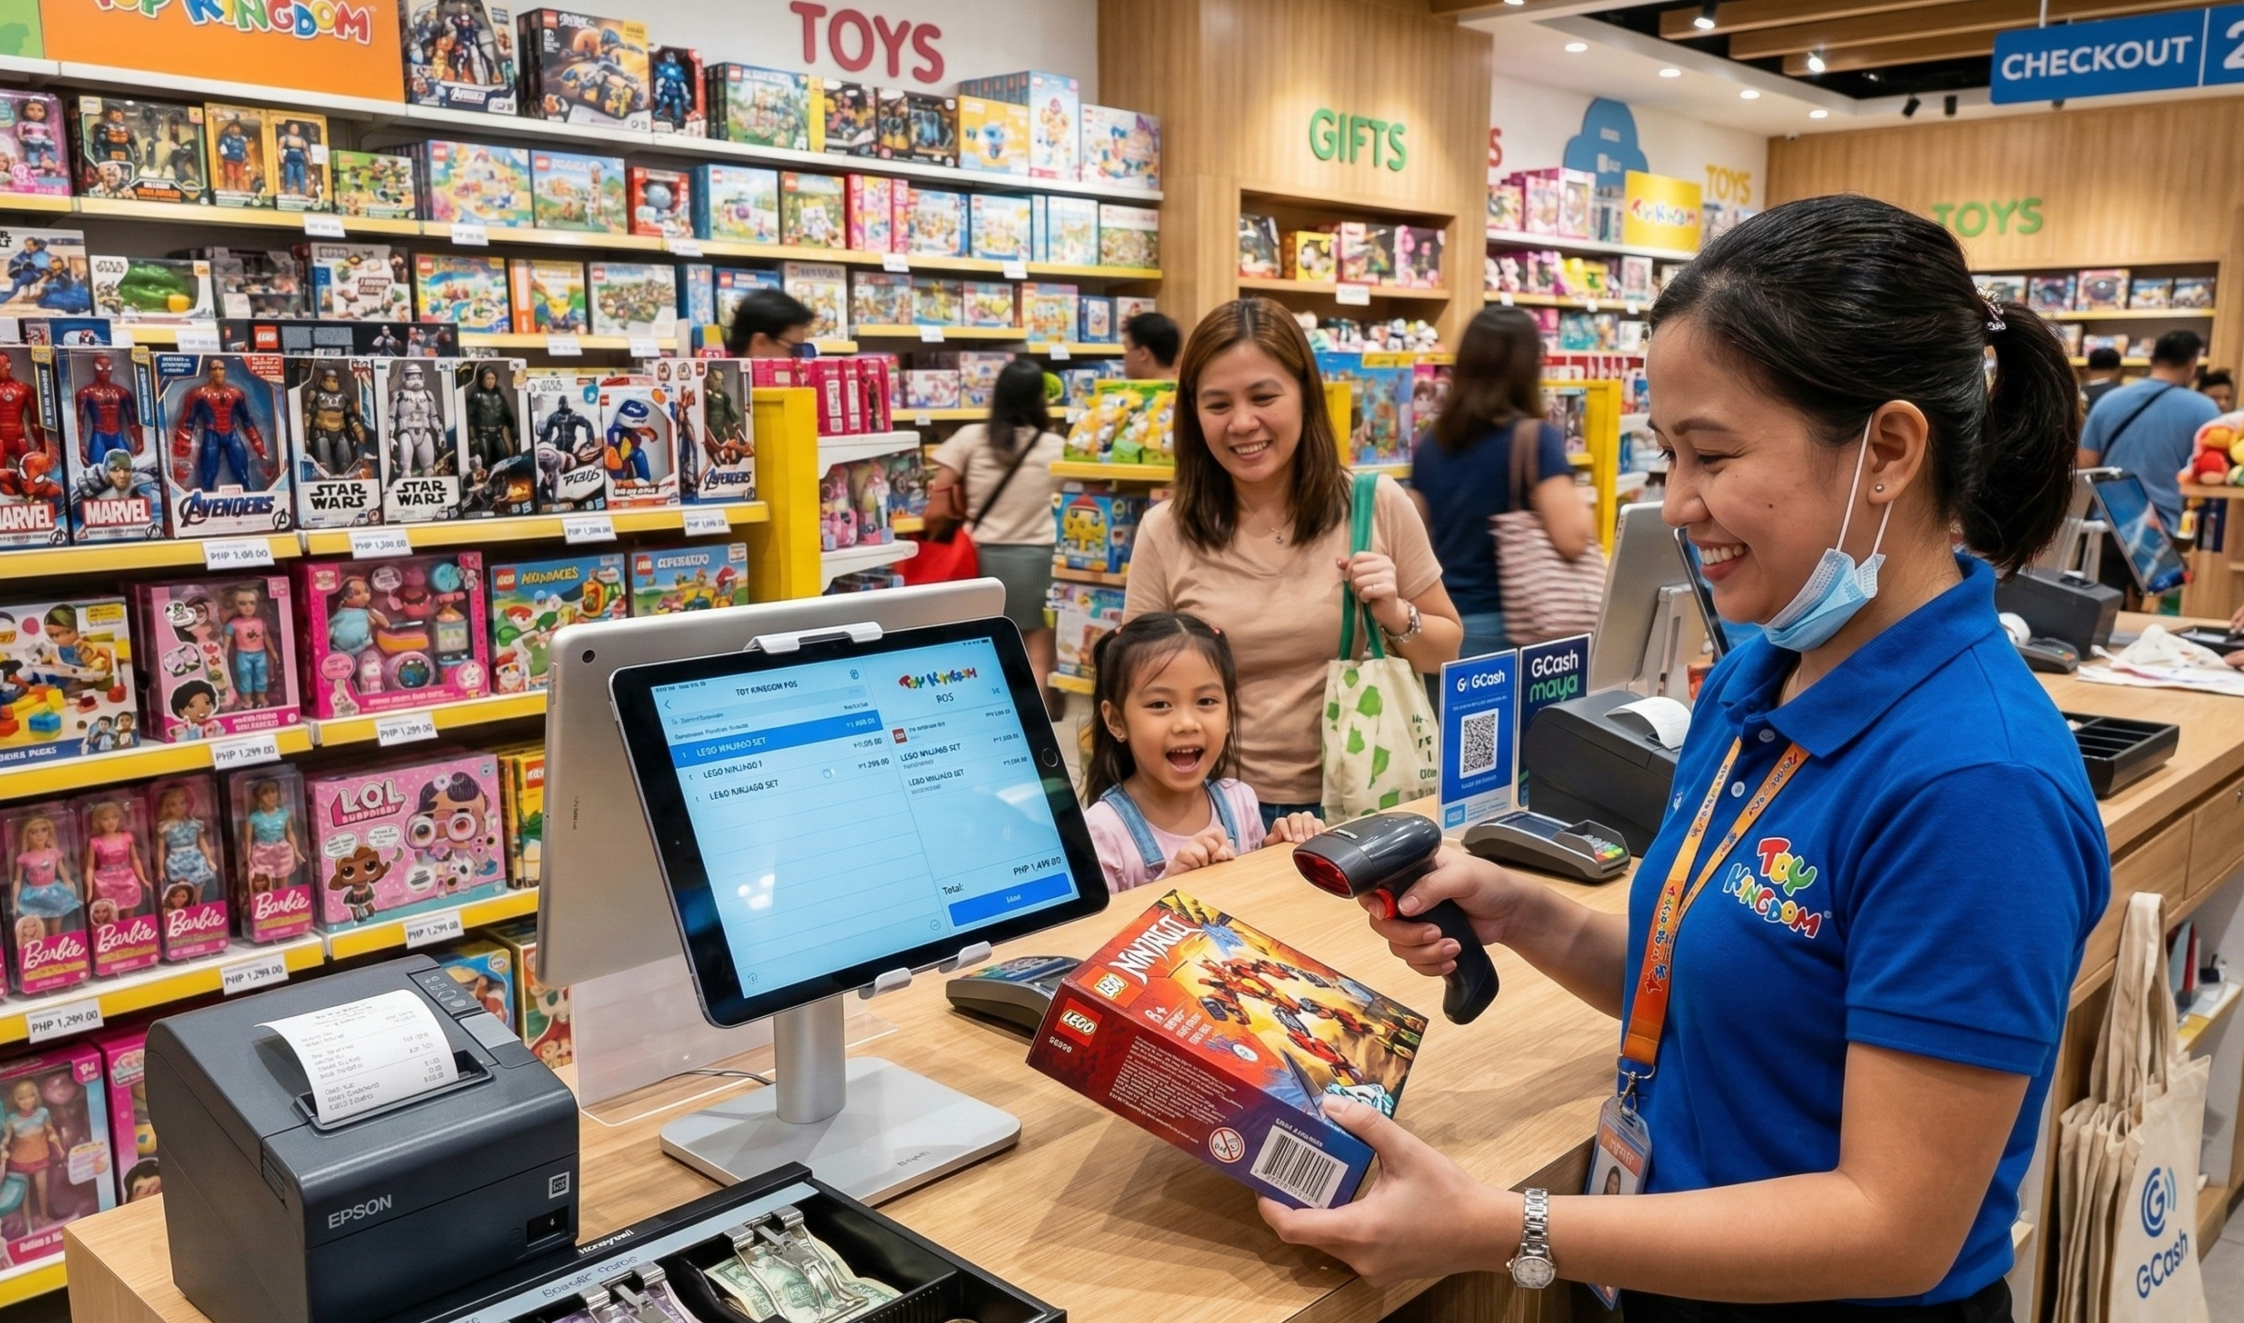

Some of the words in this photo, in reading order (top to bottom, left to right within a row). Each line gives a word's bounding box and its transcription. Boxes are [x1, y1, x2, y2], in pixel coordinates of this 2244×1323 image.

[789, 1, 945, 84] TOYS
[2001, 35, 2193, 81] CHECKOUT
[1309, 108, 1408, 172] GIFTS
[1705, 165, 1751, 205] TOYS
[1931, 197, 2043, 237] TOYS
[310, 483, 367, 497] STAR
[310, 495, 367, 510] WARS
[396, 480, 447, 493] STAR
[397, 493, 447, 506] WARS
[0, 505, 54, 530] ARVEL
[85, 498, 150, 525] MARVEL
[1471, 669, 1505, 688] GCash
[1531, 649, 1579, 678] GCash
[1530, 674, 1578, 703] maya
[1013, 864, 1030, 876] PHP
[1757, 836, 1818, 896] TOY
[254, 885, 310, 920] Barbie
[1722, 862, 1822, 939] KINGDOM
[97, 920, 157, 953] Barbie
[167, 906, 226, 938] Barbie
[23, 936, 85, 969] Barbie
[1108, 914, 1204, 986] NINJAGO
[32, 1020, 54, 1034] PHP
[328, 1194, 392, 1230] EPSON
[2136, 1228, 2188, 1299] GCash
